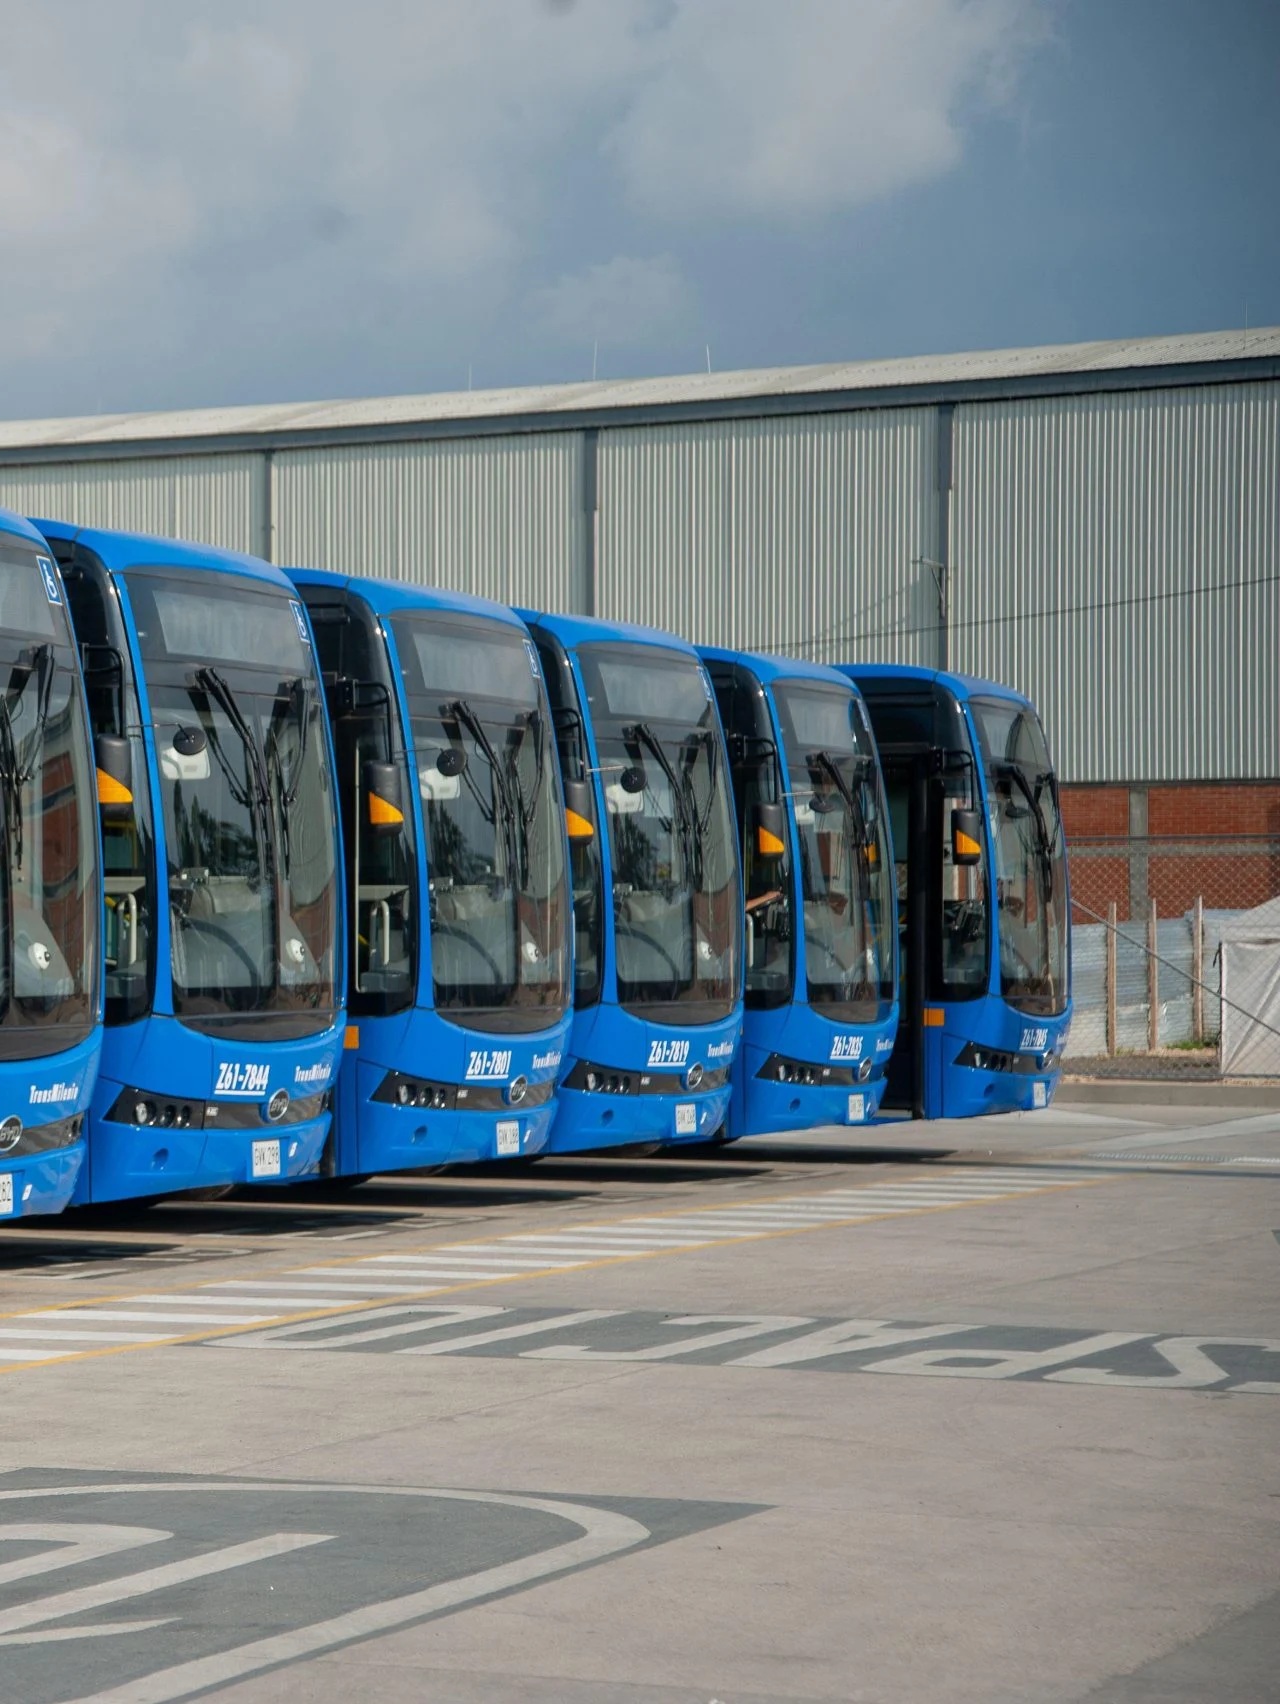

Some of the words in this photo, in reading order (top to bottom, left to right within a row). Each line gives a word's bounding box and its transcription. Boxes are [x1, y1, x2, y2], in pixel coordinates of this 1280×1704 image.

[648, 1041, 689, 1062] Z61-7819
[294, 1065, 331, 1082] TransMilenio
[467, 1051, 512, 1075] Z61-7801
[216, 1063, 270, 1090] Z61-7844
[29, 1083, 79, 1104] TransMilenio
